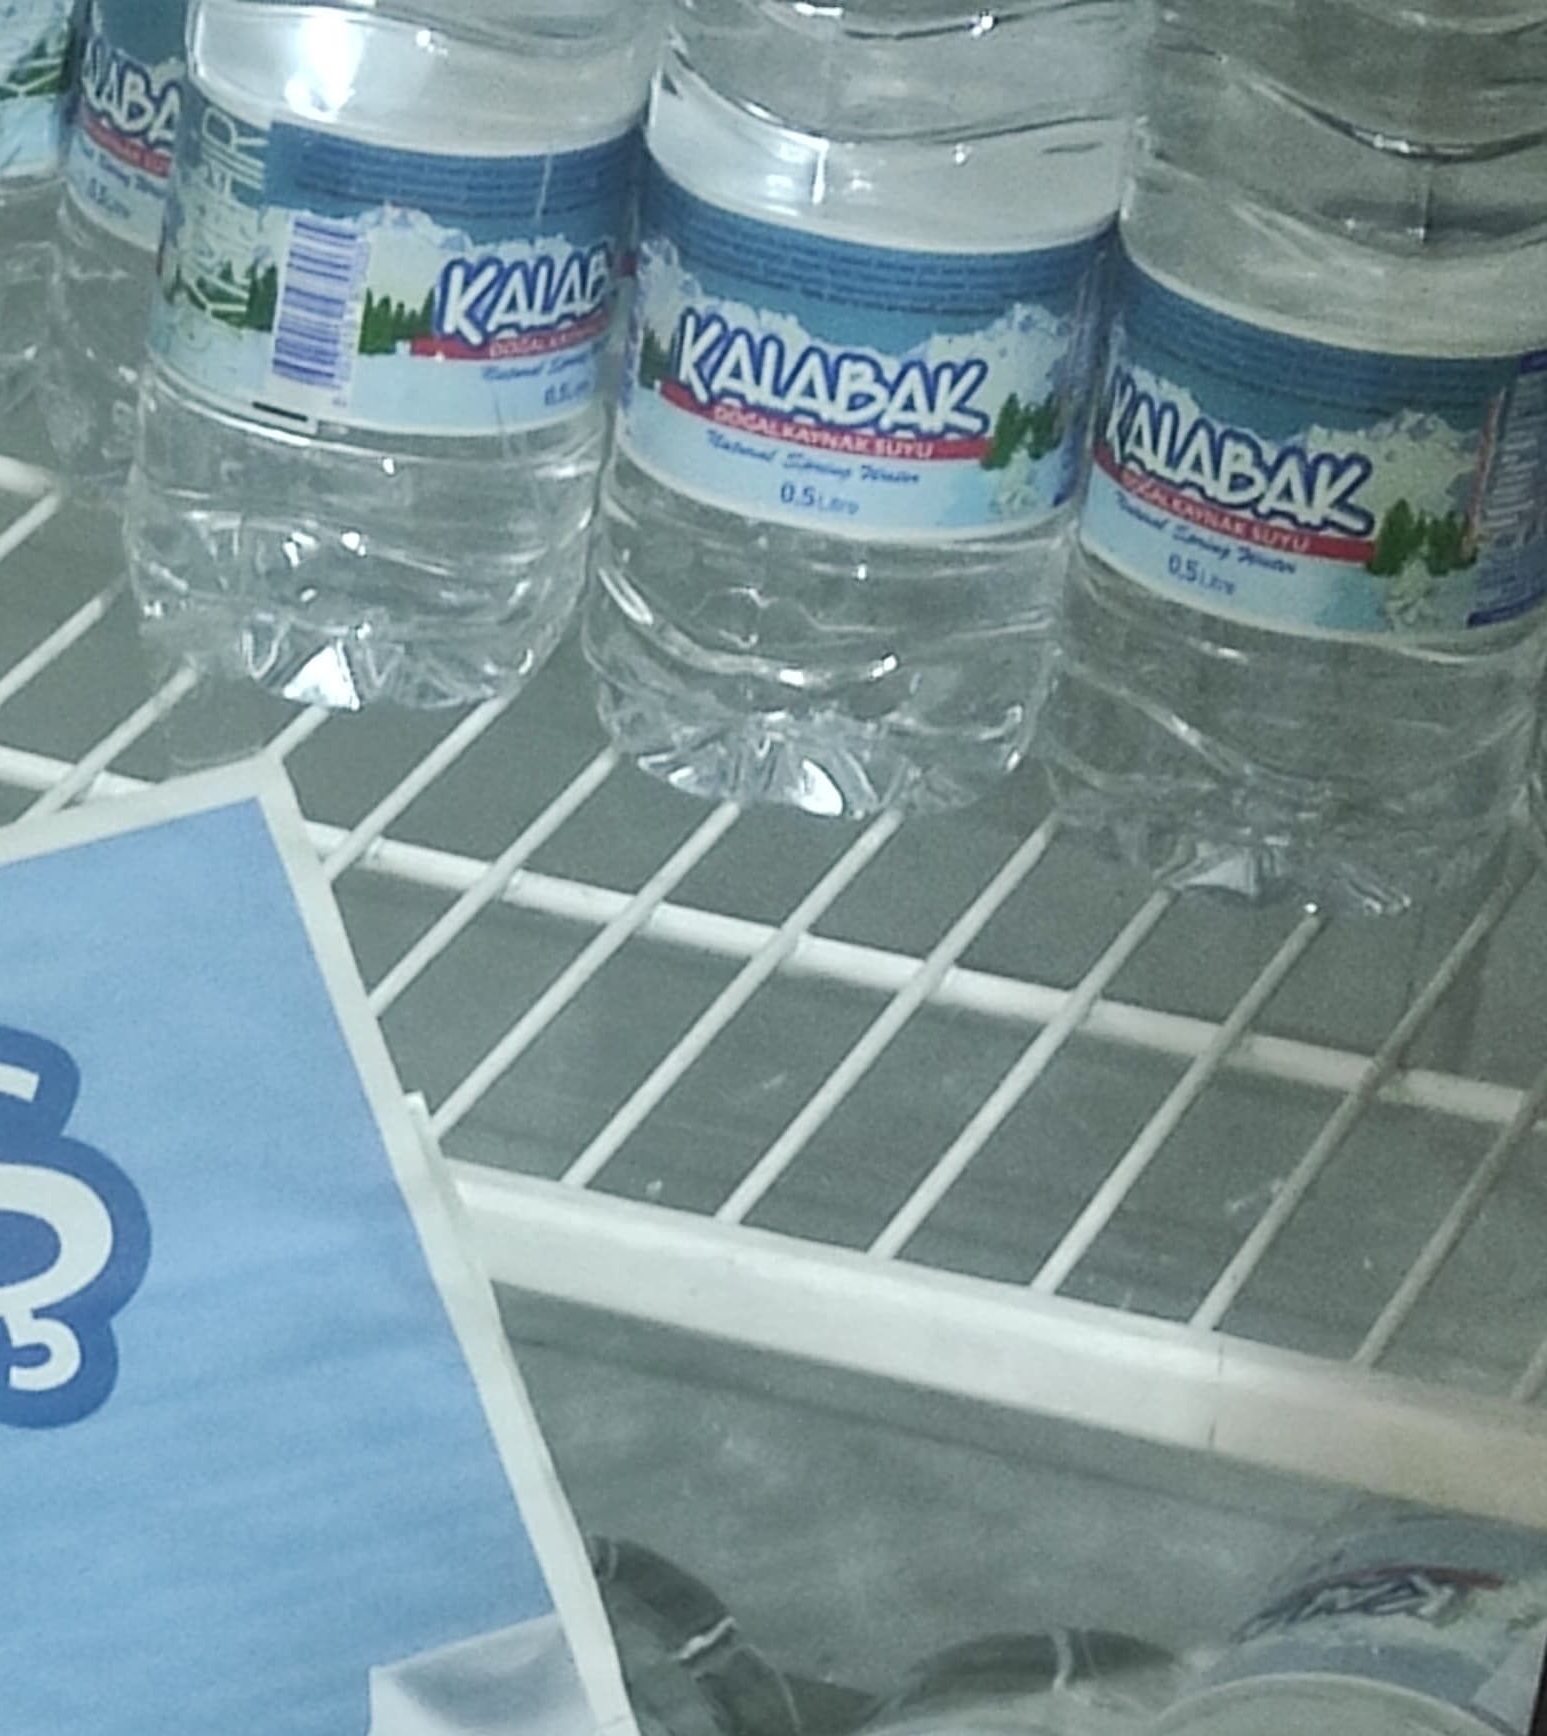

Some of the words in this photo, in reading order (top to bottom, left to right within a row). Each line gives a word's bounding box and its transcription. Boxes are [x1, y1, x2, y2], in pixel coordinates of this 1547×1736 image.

[432, 243, 609, 347] KALAB
[675, 307, 989, 439] KALABAK
[1106, 367, 1374, 537] KALABAK
